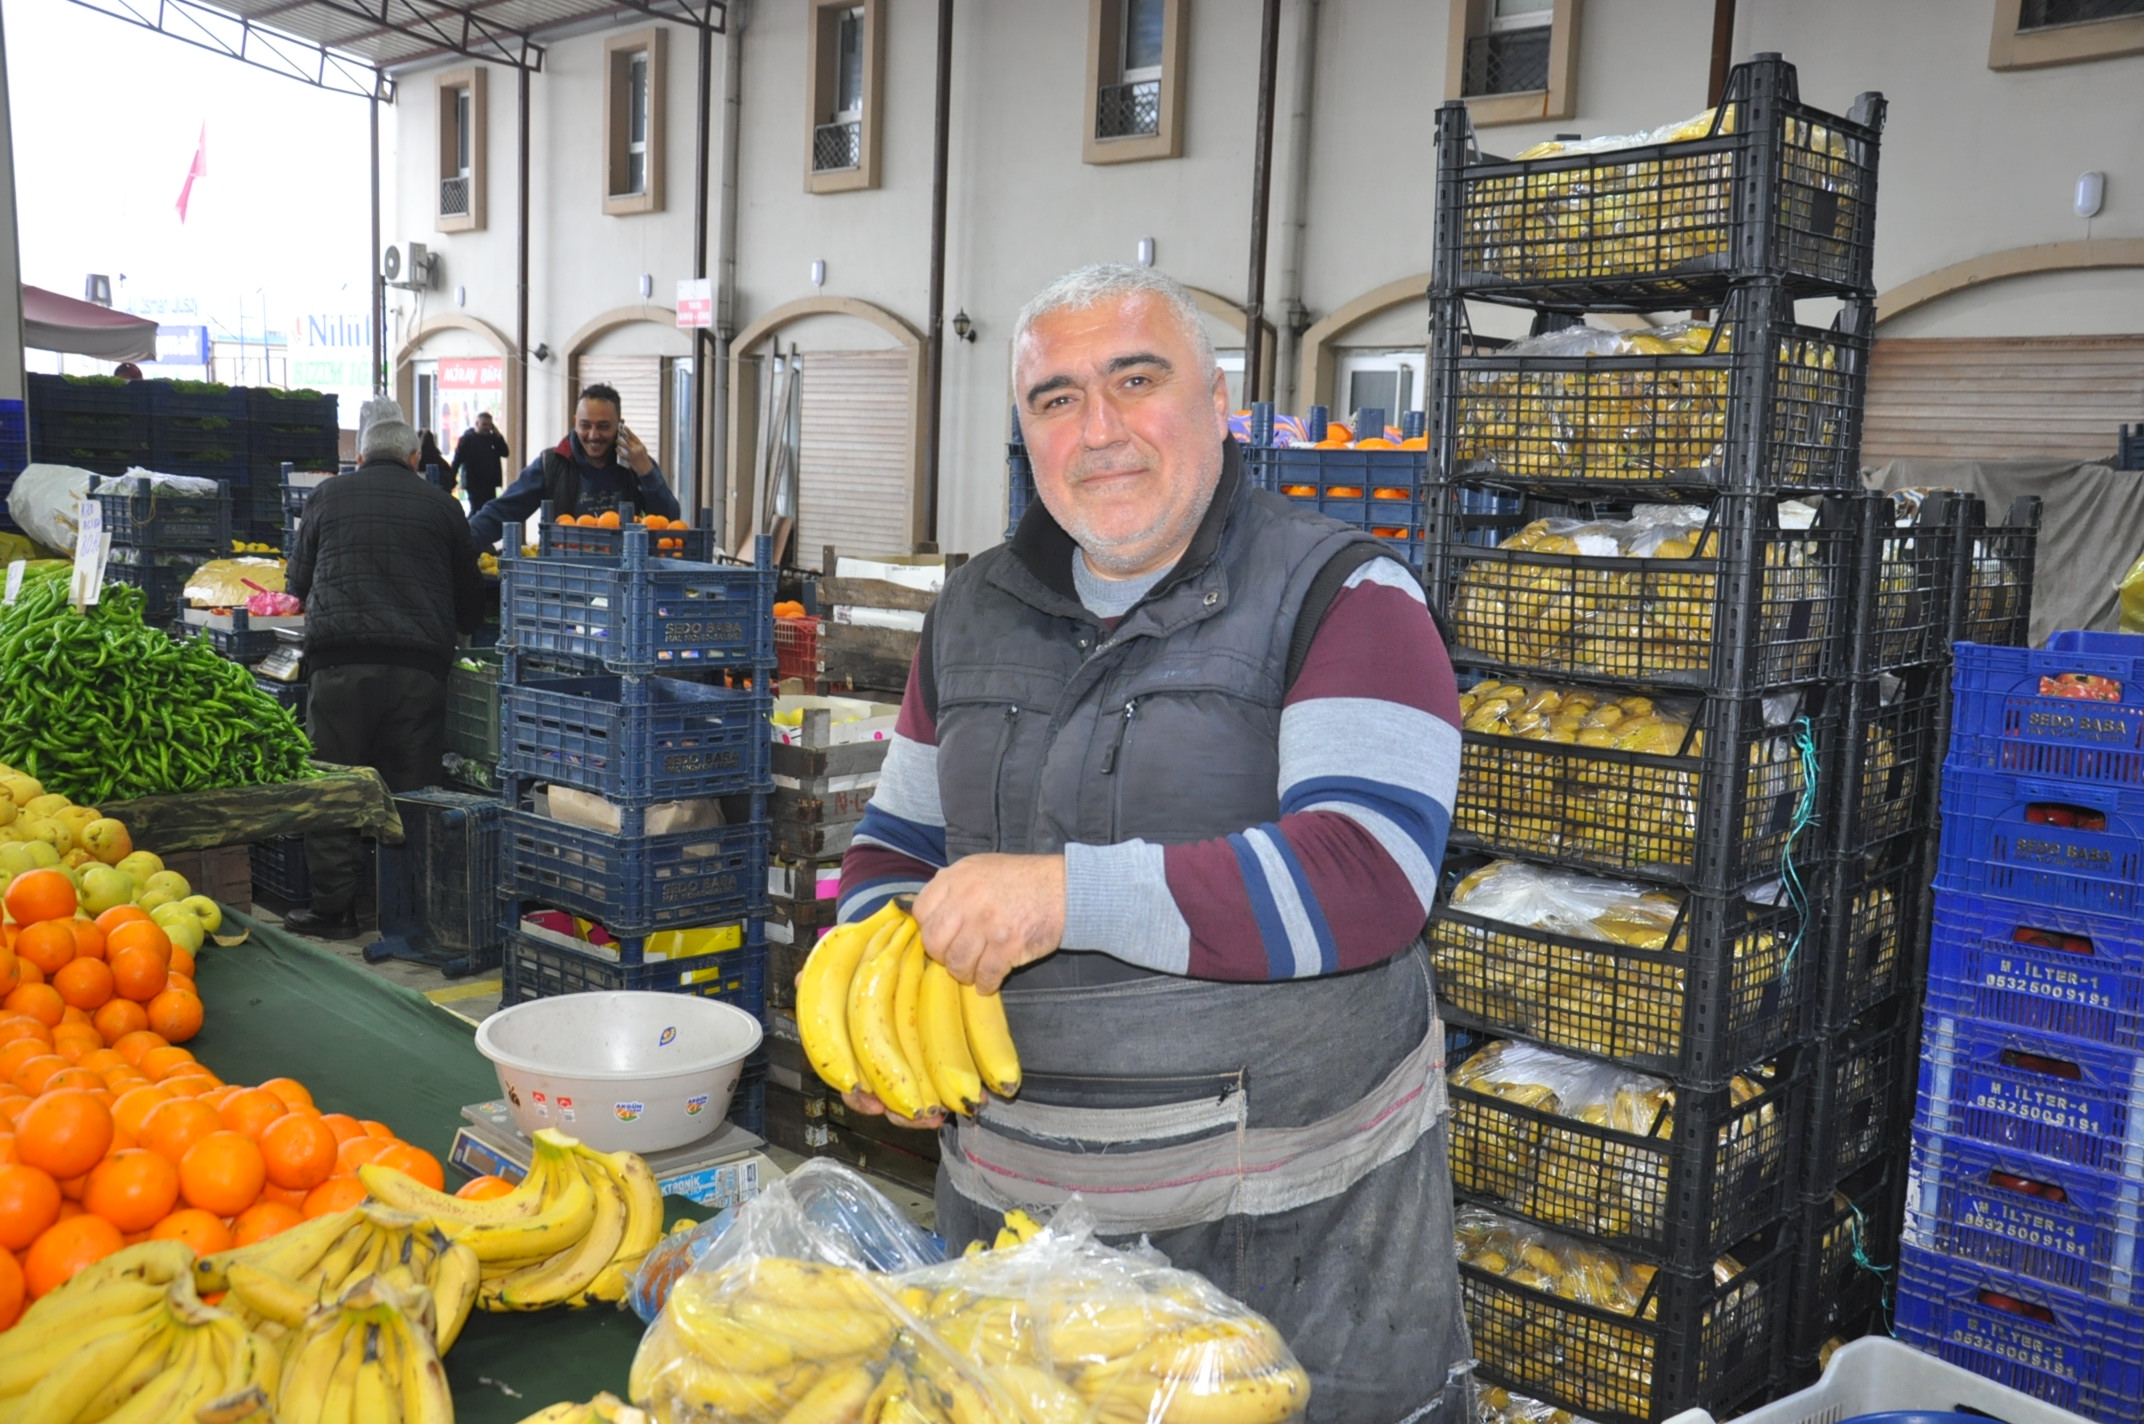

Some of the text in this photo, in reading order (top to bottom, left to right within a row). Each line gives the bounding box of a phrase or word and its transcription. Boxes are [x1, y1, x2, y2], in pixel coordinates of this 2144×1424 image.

[665, 621, 742, 635] SEDO BABA
[2029, 712, 2127, 735] SEDO BABA
[2016, 837, 2061, 856] SEDO
[2066, 844, 2113, 864] BABA
[661, 1174, 700, 1196] KTRONİK
